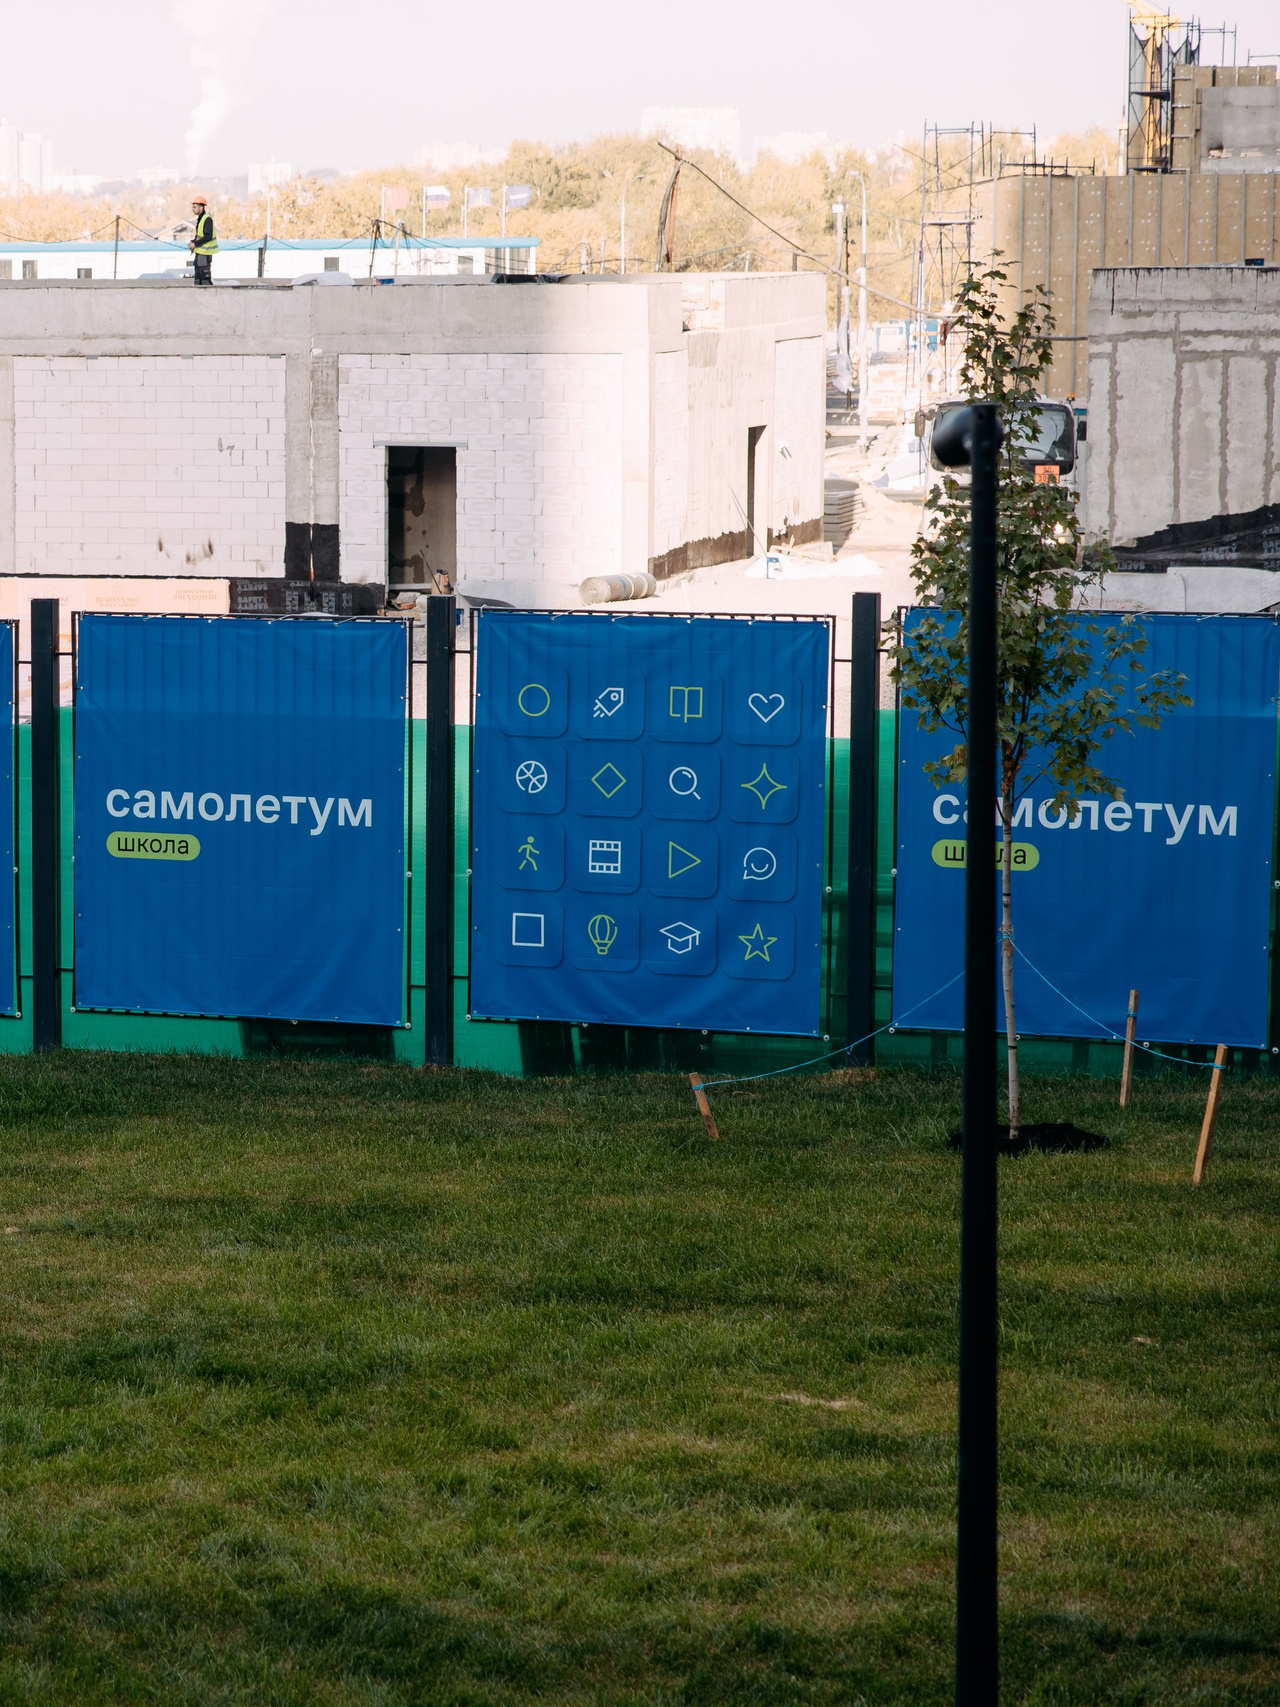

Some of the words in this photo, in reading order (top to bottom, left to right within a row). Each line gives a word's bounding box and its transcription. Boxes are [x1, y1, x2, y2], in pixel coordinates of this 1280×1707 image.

[1117, 560, 1145, 570] SAFET
[237, 596, 268, 604] SAFETY
[106, 788, 372, 835] самолетум
[932, 793, 1238, 845] смолетум
[117, 837, 189, 854] школа
